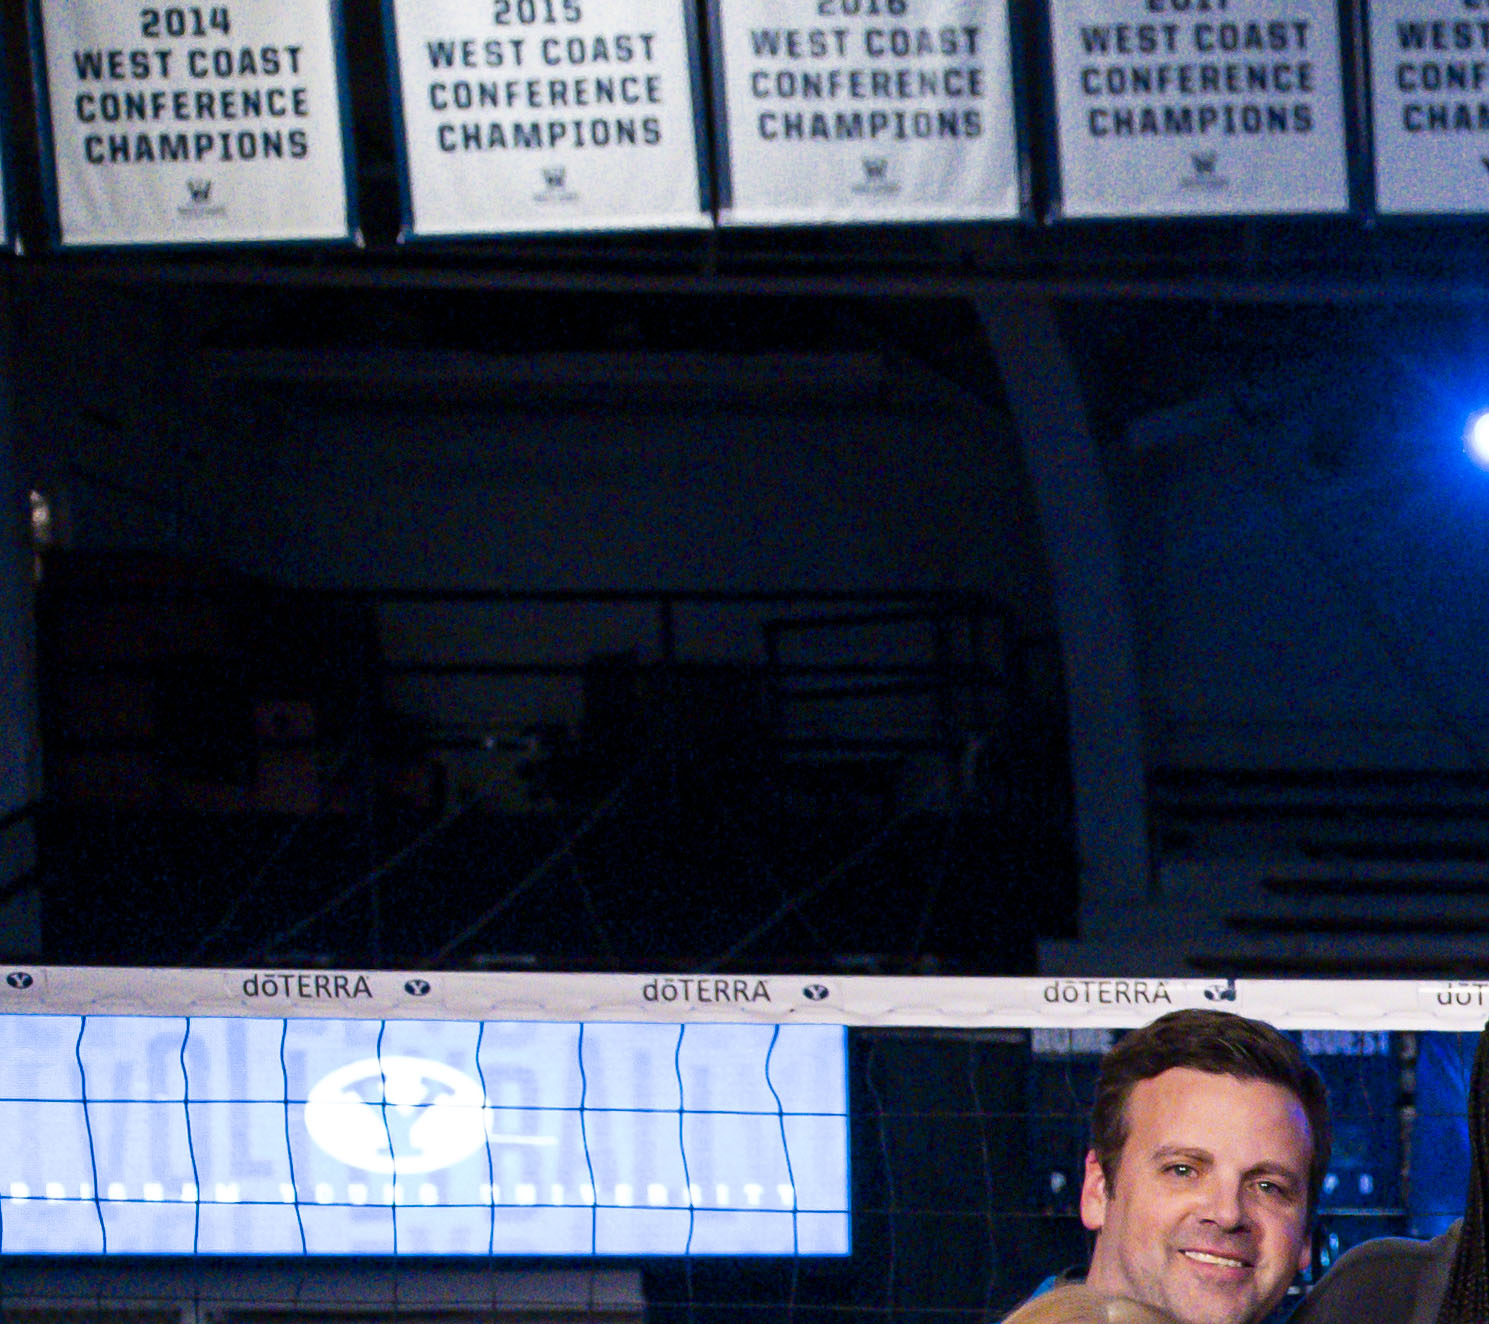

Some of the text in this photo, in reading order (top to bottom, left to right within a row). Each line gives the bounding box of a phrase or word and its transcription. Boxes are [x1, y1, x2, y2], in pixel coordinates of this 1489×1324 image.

[141, 8, 230, 38] 2014
[494, 0, 581, 25] 2015
[427, 33, 654, 69] WEST COAST
[751, 23, 981, 59] WEST COAST
[1081, 21, 1309, 54] WEST COAST
[73, 47, 300, 81] WEST COAST
[1081, 62, 1313, 95] CONFERENCE
[429, 76, 660, 111] CONFERENCE
[752, 64, 983, 99] CONFERENCE
[75, 89, 307, 124] CONFERENCE
[759, 107, 982, 140] CHAMPIONS
[1089, 104, 1313, 136] CHAMPIONS
[84, 131, 307, 166] CHAMPIONS
[438, 117, 661, 153] CHAMPIONS
